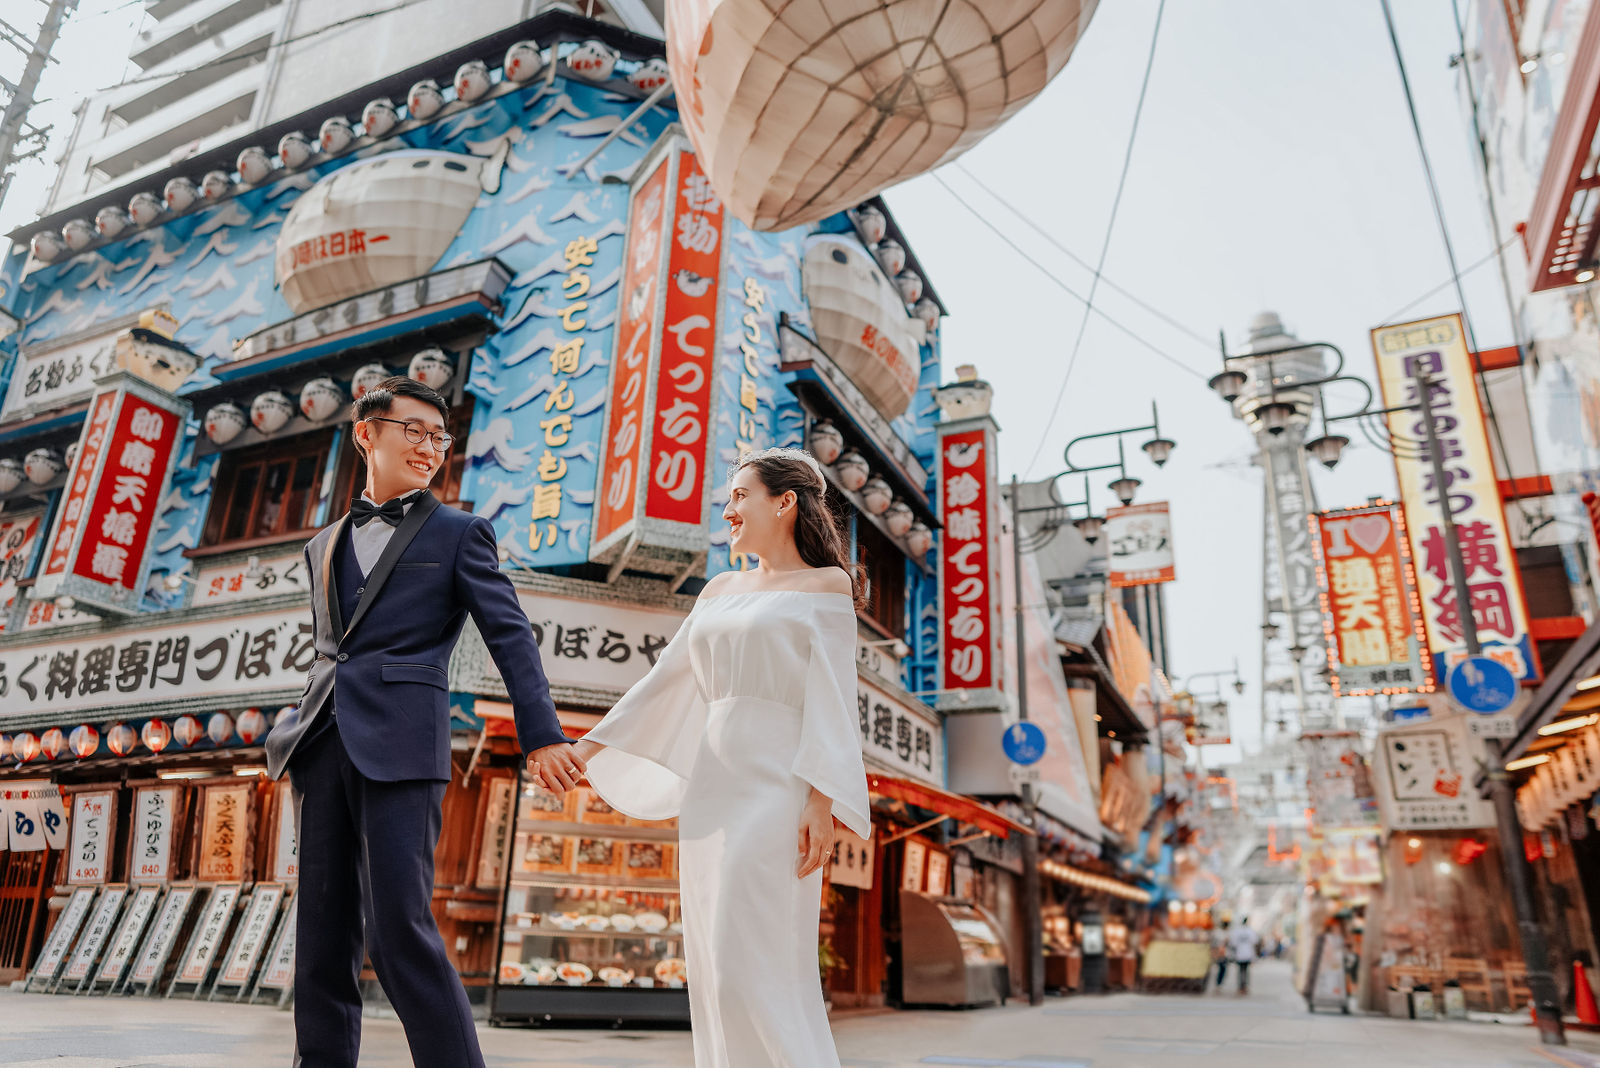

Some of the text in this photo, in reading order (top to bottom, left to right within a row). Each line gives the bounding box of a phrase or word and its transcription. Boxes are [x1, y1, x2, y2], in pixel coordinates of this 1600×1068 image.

[528, 235, 598, 552] 安うて何んでも旨い
[607, 321, 648, 513] てっちり
[655, 313, 711, 502] てっちり
[947, 472, 985, 683] 珍味てっちり
[1322, 518, 1355, 557] I
[1329, 556, 1391, 667] 通天閣
[1421, 520, 1516, 643] 横綱
[141, 864, 160, 875] 840
